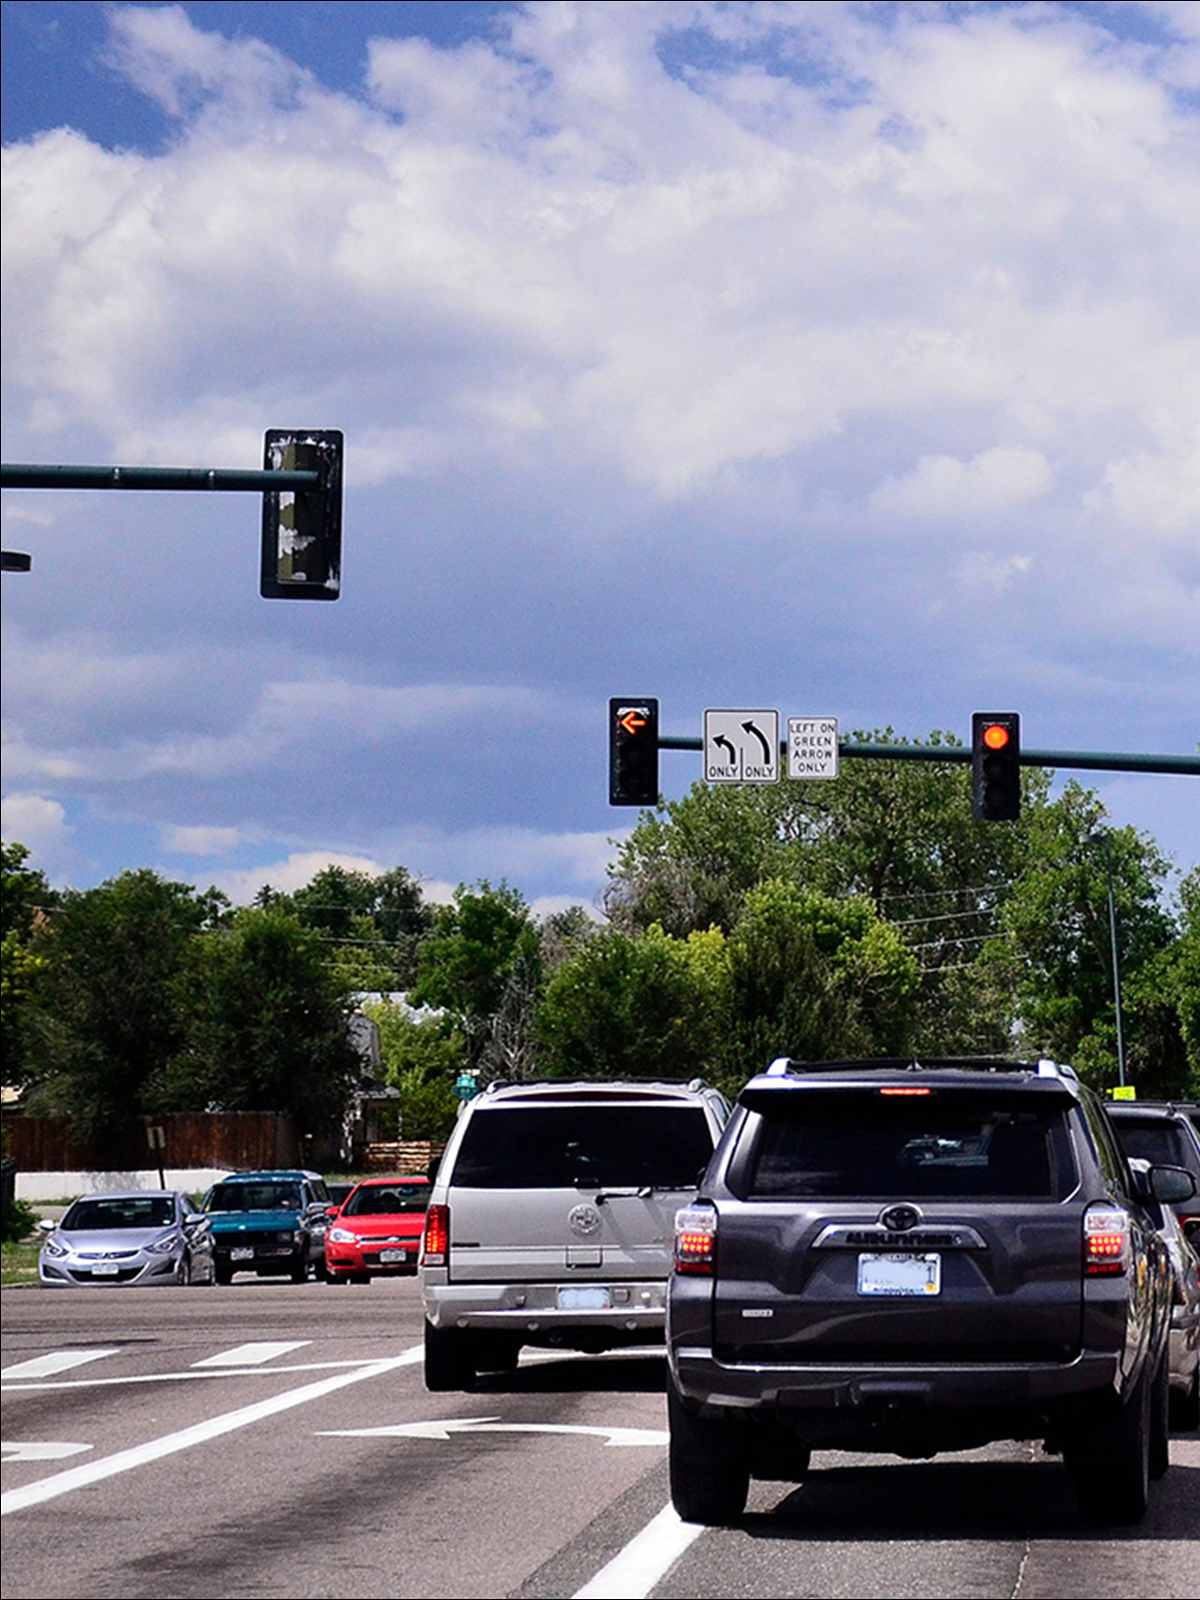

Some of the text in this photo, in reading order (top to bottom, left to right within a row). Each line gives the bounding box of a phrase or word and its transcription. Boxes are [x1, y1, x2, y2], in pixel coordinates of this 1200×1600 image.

[791, 723, 835, 733] LEFT ON
[794, 736, 831, 746] GREEN
[793, 750, 832, 759] ARROW
[709, 766, 738, 778] ONLY
[745, 766, 774, 778] ONLY
[798, 762, 827, 773] ONLY
